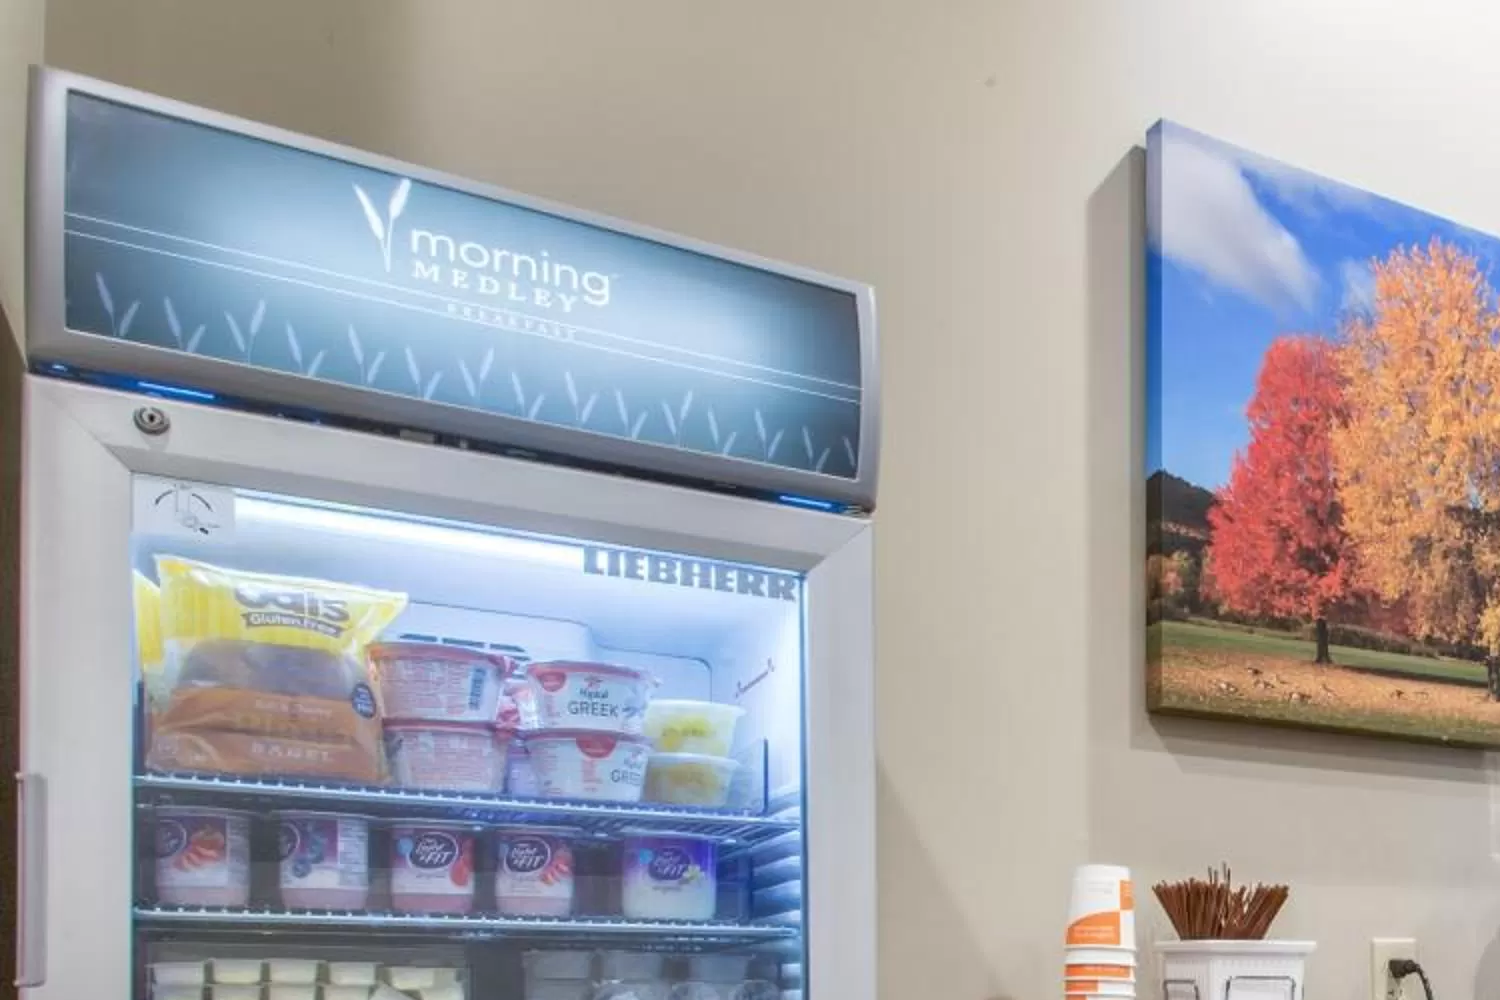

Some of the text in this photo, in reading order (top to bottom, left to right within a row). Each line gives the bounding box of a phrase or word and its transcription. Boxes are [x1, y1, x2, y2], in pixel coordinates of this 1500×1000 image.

[411, 228, 610, 306] morning
[411, 260, 579, 313] MEDLEY
[583, 547, 797, 602] LIEBHERR
[568, 702, 619, 718] GREEK
